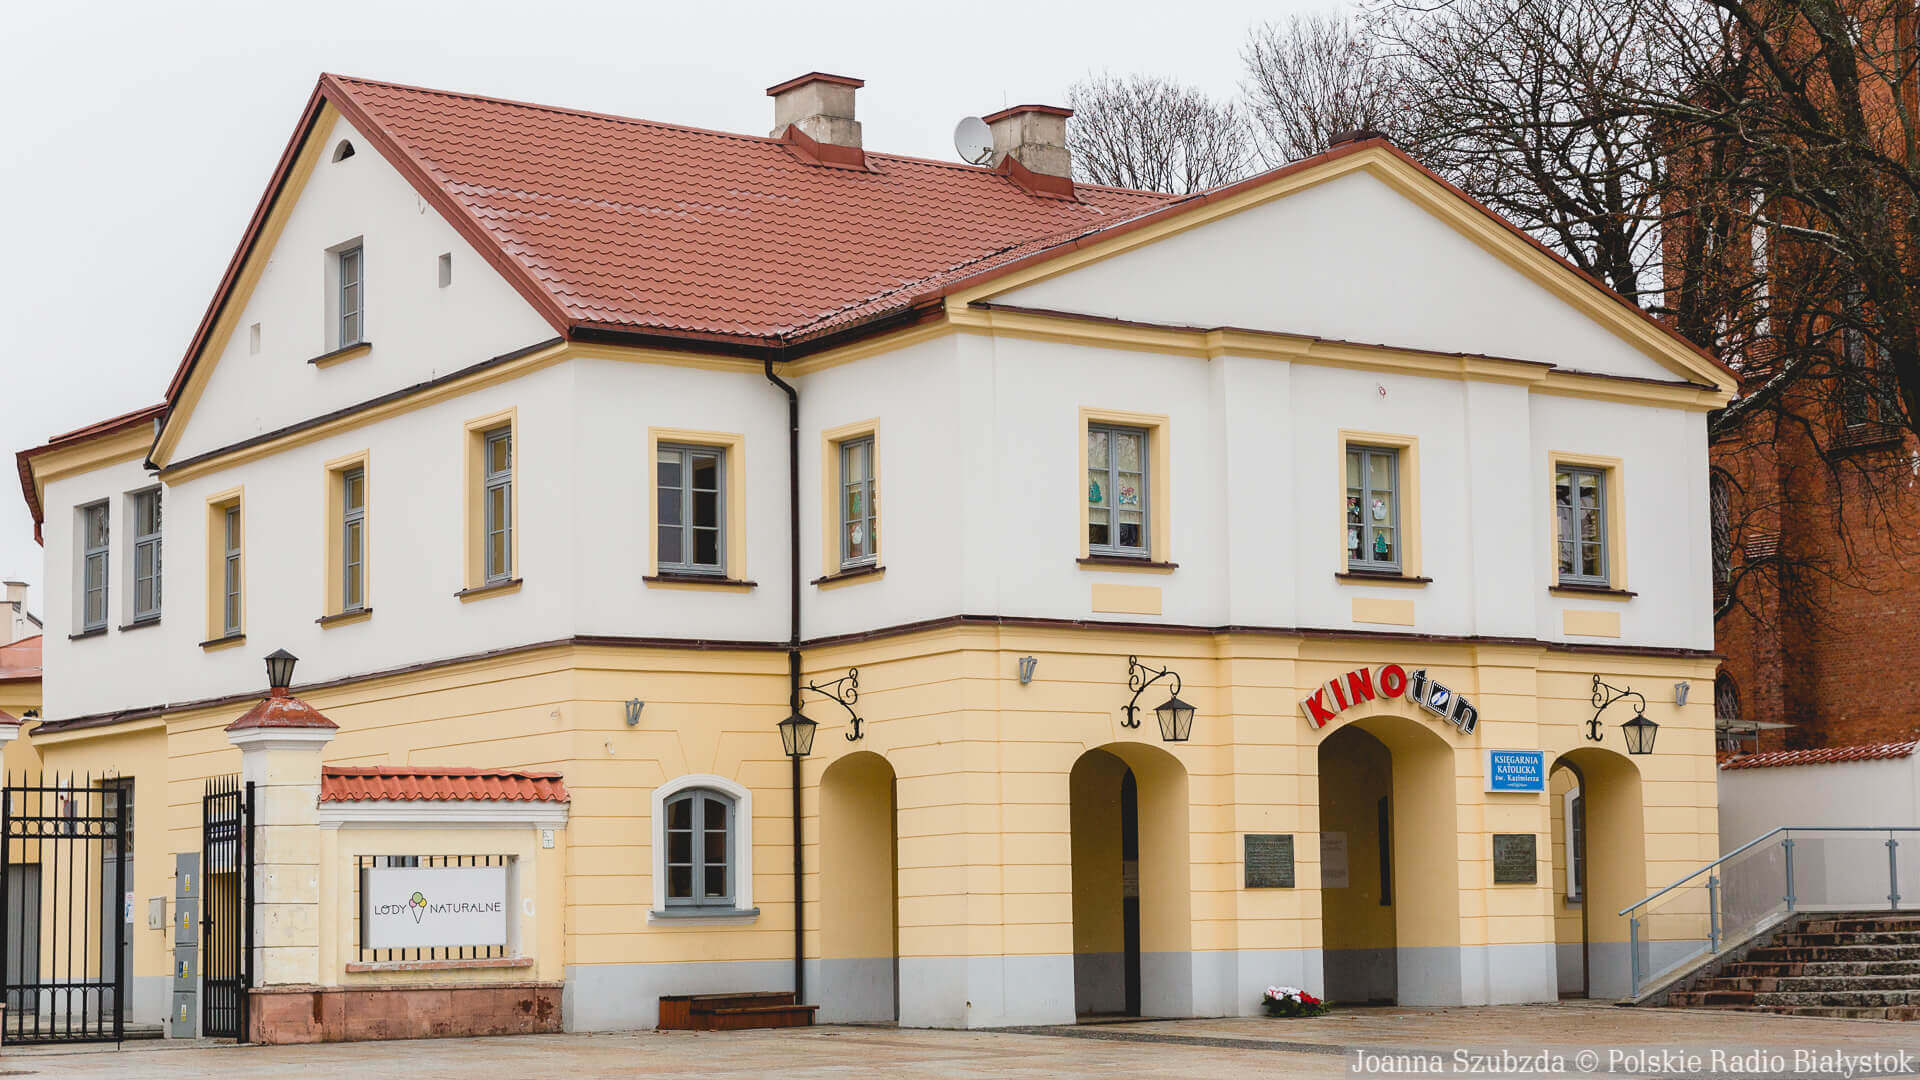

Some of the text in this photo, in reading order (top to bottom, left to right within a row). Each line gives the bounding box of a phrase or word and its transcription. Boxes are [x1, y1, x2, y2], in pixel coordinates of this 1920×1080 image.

[1495, 755, 1538, 766] KSIĘGARNIA
[1497, 766, 1536, 774] KATOLICKA
[430, 902, 501, 914] NATURALNE
